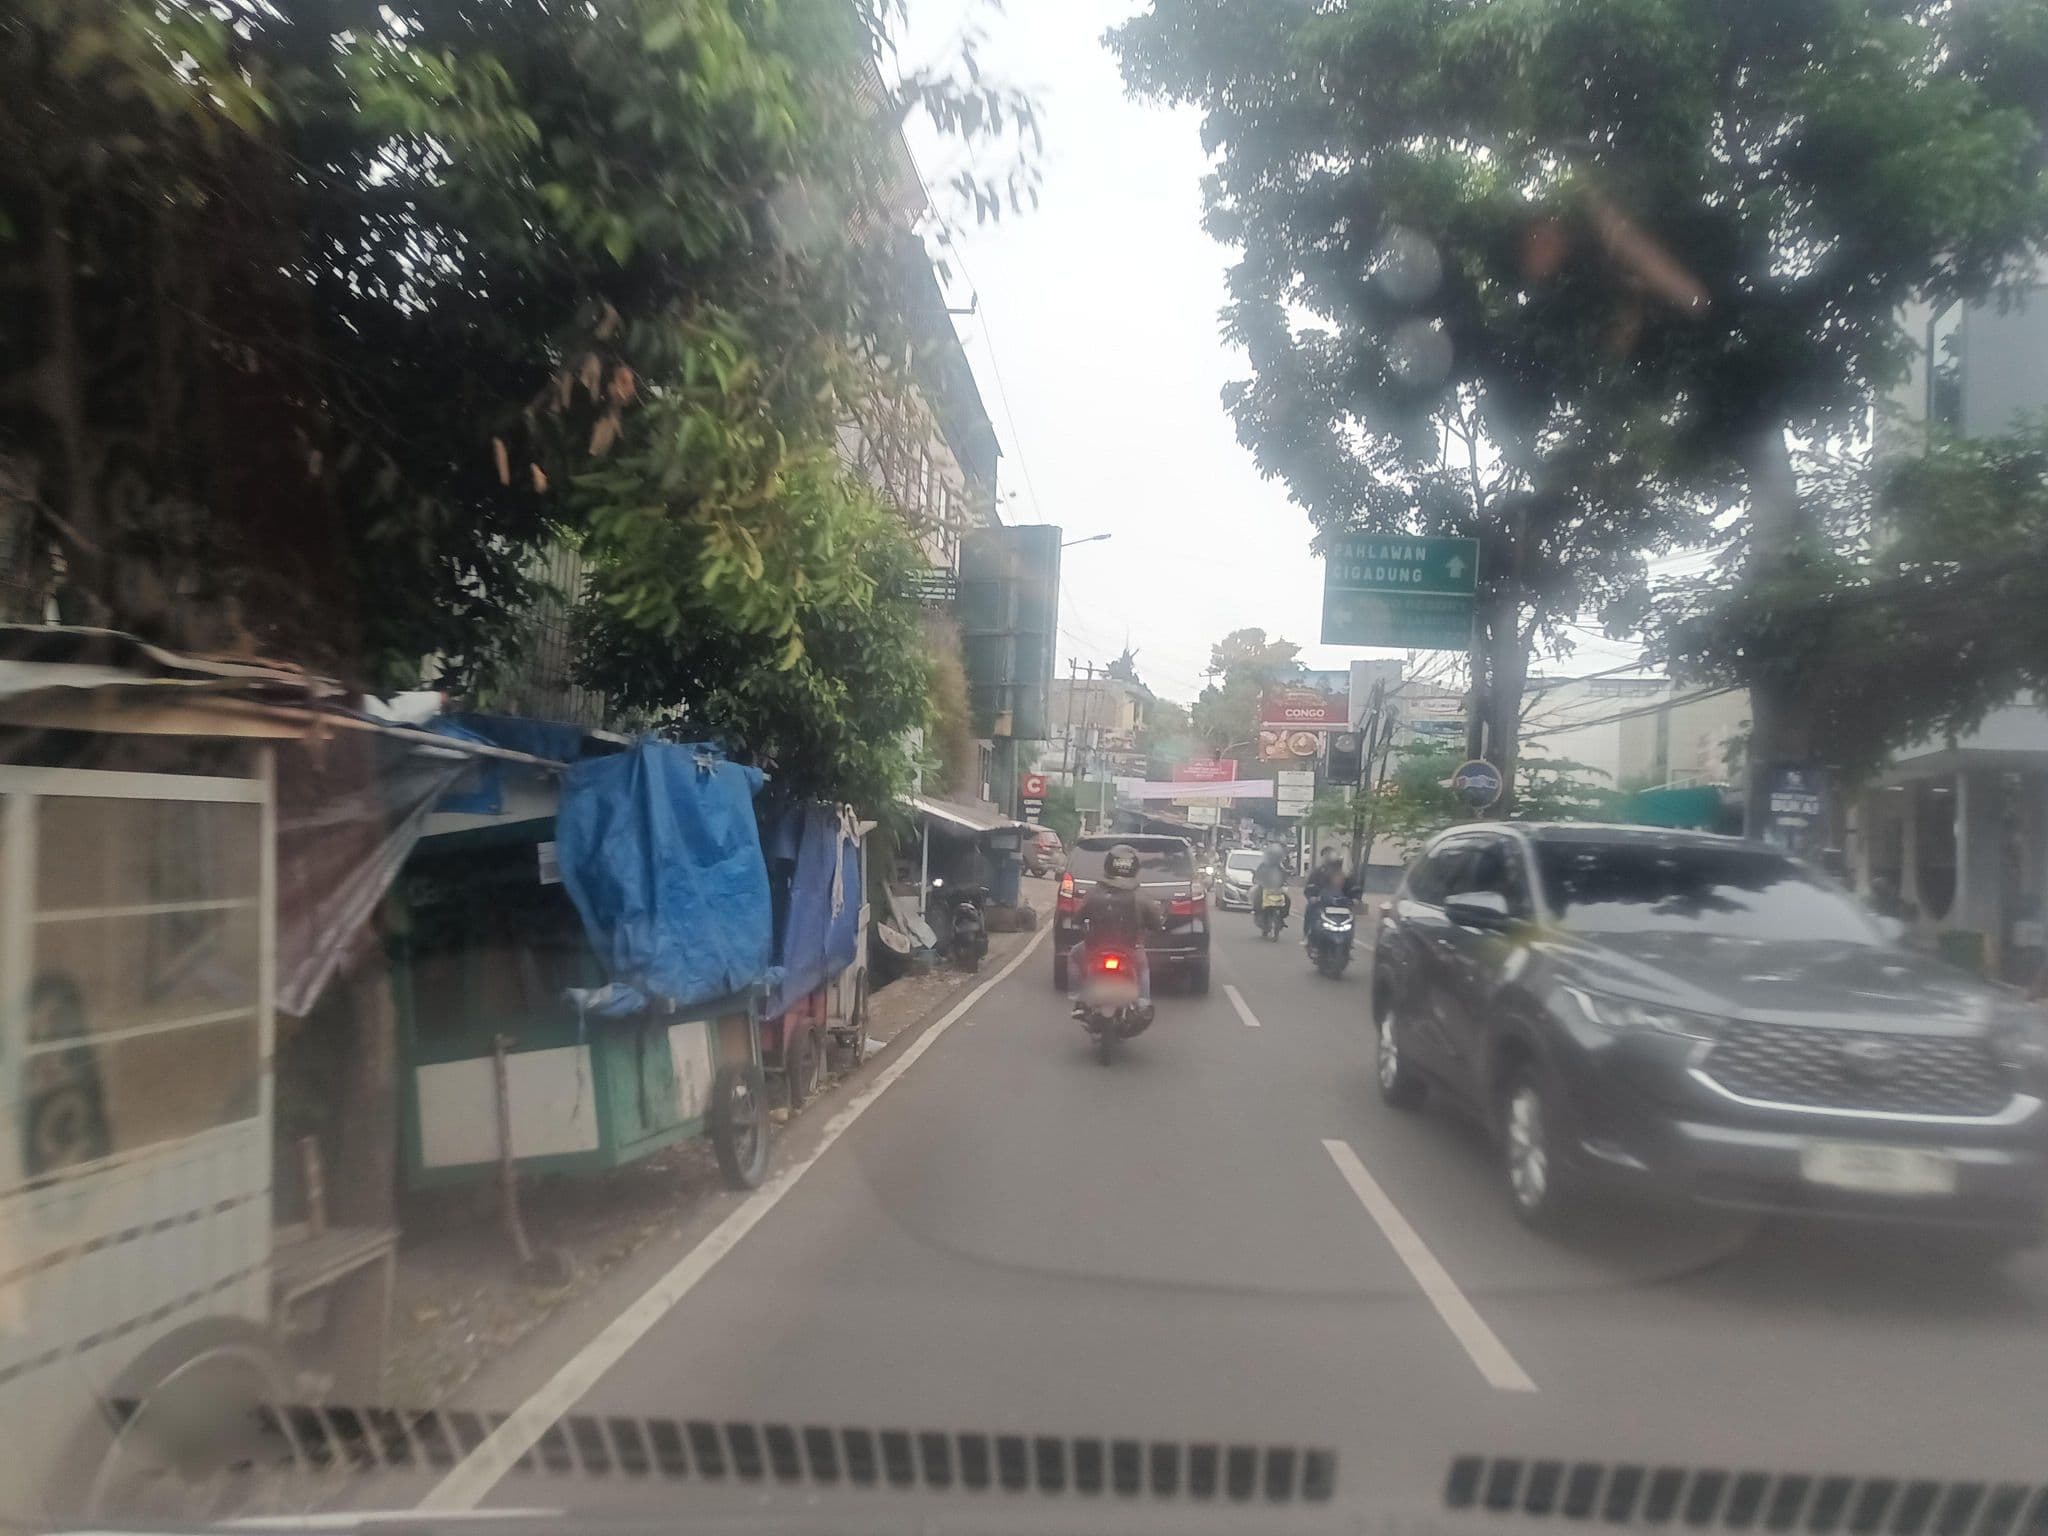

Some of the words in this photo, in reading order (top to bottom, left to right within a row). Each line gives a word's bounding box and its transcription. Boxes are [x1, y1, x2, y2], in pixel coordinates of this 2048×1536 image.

[1334, 543, 1426, 561] PAHLAWAN
[1334, 566, 1423, 583] CIGADUNG
[1284, 708, 1325, 718] CONGO
